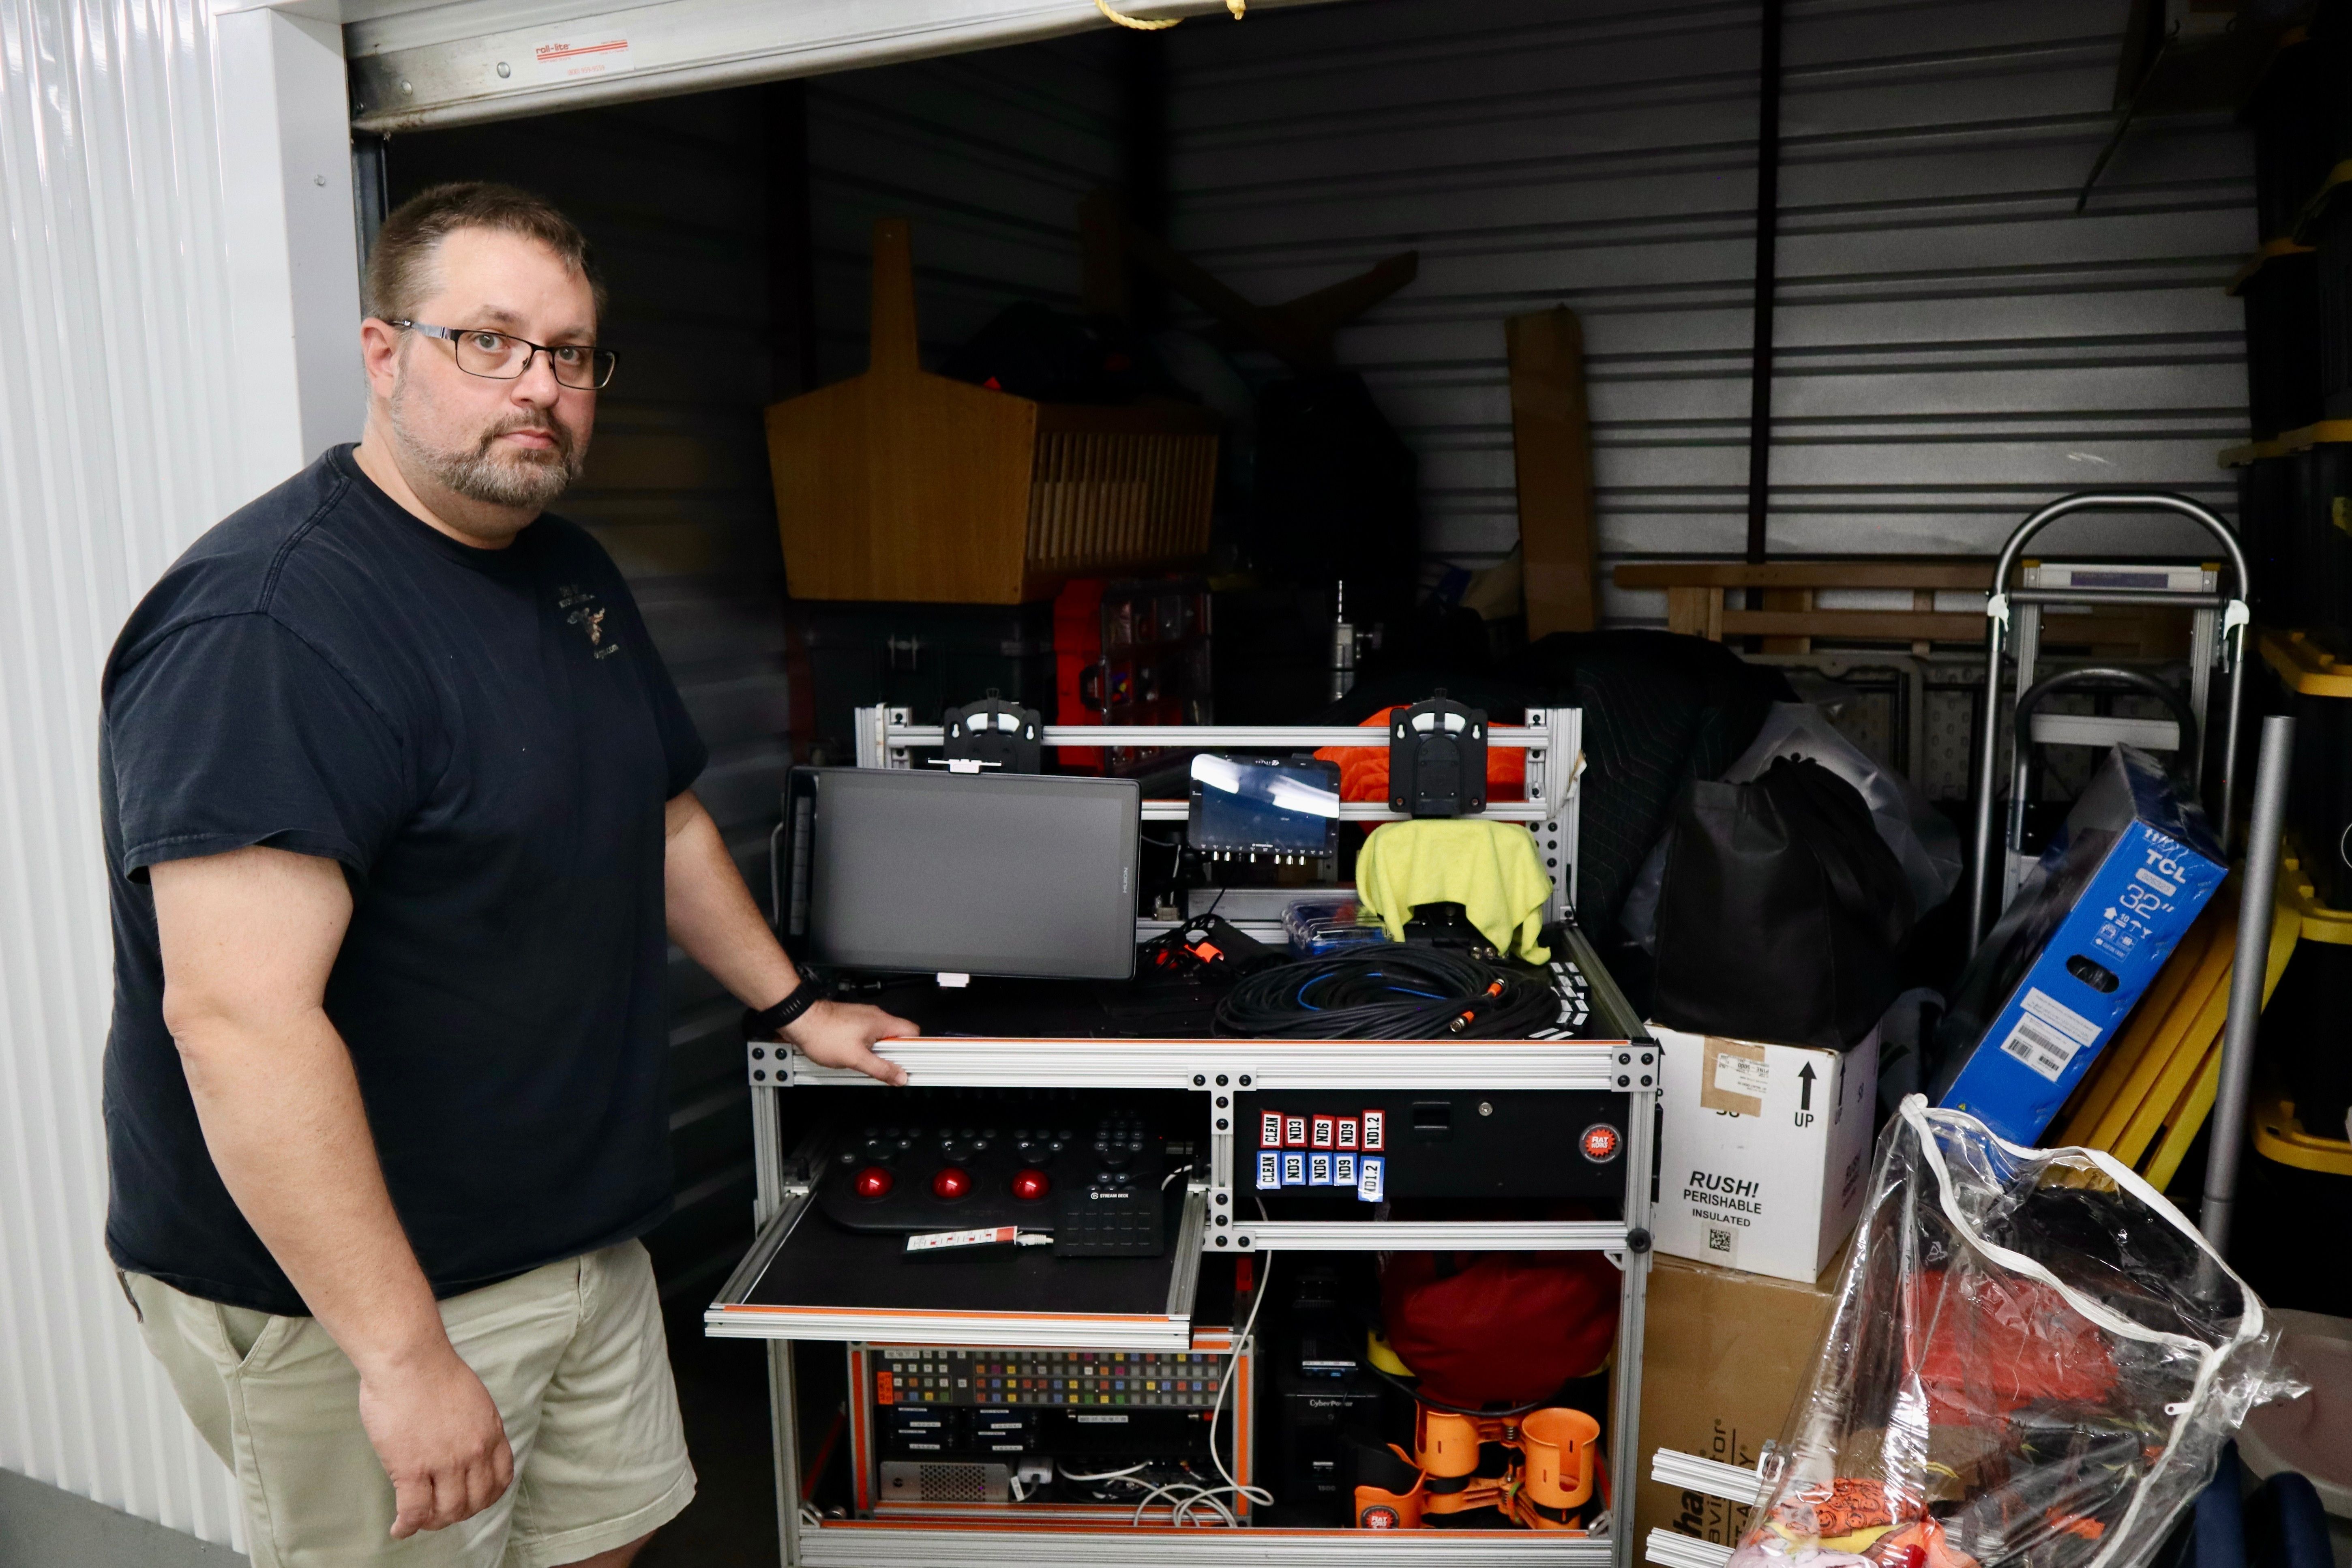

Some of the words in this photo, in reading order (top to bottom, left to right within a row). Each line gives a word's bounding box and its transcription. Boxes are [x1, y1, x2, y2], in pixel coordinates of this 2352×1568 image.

[536, 43, 569, 54] roll-lite
[2146, 849, 2186, 885] TCL
[1794, 1111, 1814, 1128] UP
[1265, 1117, 1278, 1143] CLEAN
[1289, 1121, 1302, 1140] ND3
[1316, 1123, 1329, 1143] ND6
[1341, 1123, 1354, 1143] ND9
[1367, 1117, 1380, 1145] ND1.2
[1262, 1156, 1275, 1183] CLEAN
[1287, 1158, 1300, 1179] ND3
[1314, 1159, 1327, 1179] ND6
[1338, 1159, 1351, 1180] ND9
[1689, 1171, 1760, 1199] RUSH!
[1683, 1189, 1762, 1215] PERISHABLE
[1692, 1208, 1751, 1228] INSULATED
[1310, 1399, 1353, 1407] CyberPoer
